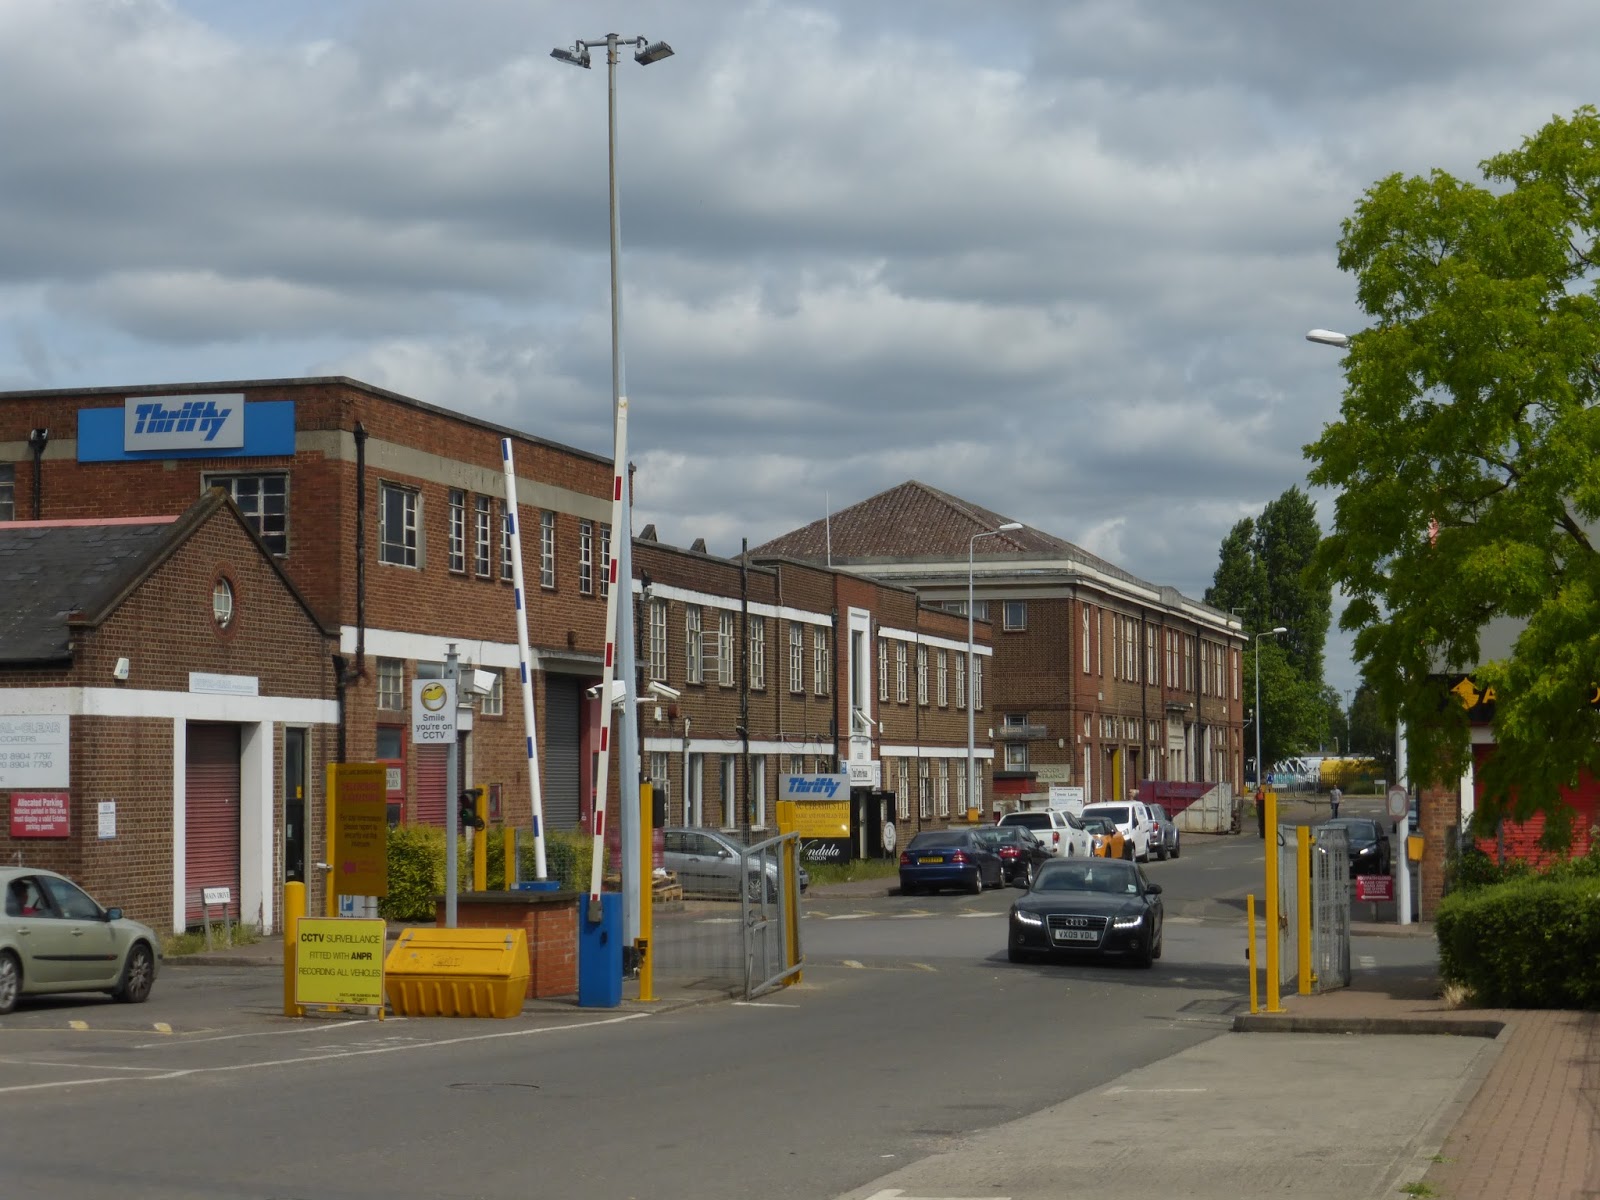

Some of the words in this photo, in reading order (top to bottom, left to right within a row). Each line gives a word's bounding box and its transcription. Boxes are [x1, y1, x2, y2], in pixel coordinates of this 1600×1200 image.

[134, 401, 232, 441] Thrifty
[422, 713, 445, 721] Smile
[416, 723, 440, 732] you're
[422, 731, 445, 739] CCTV
[9, 752, 31, 760] 8904
[33, 752, 52, 760] 7797
[9, 761, 30, 769] 8904
[33, 761, 53, 769] 7790
[788, 777, 840, 798] Thrifty
[17, 798, 42, 807] Allocated
[43, 798, 63, 808] Parking
[25, 823, 40, 831] parking
[799, 839, 841, 857] Vndula
[301, 933, 324, 942] CCTV
[326, 934, 380, 944] SURVEILLANCE
[1058, 931, 1078, 939] VX09
[1079, 932, 1095, 940] VDL
[309, 951, 331, 960] FITTED
[332, 952, 350, 960] WITH
[350, 952, 373, 960] ANPR
[298, 967, 336, 976] RECORDING
[336, 968, 349, 977] ALL
[350, 968, 381, 977] VEHICLES
